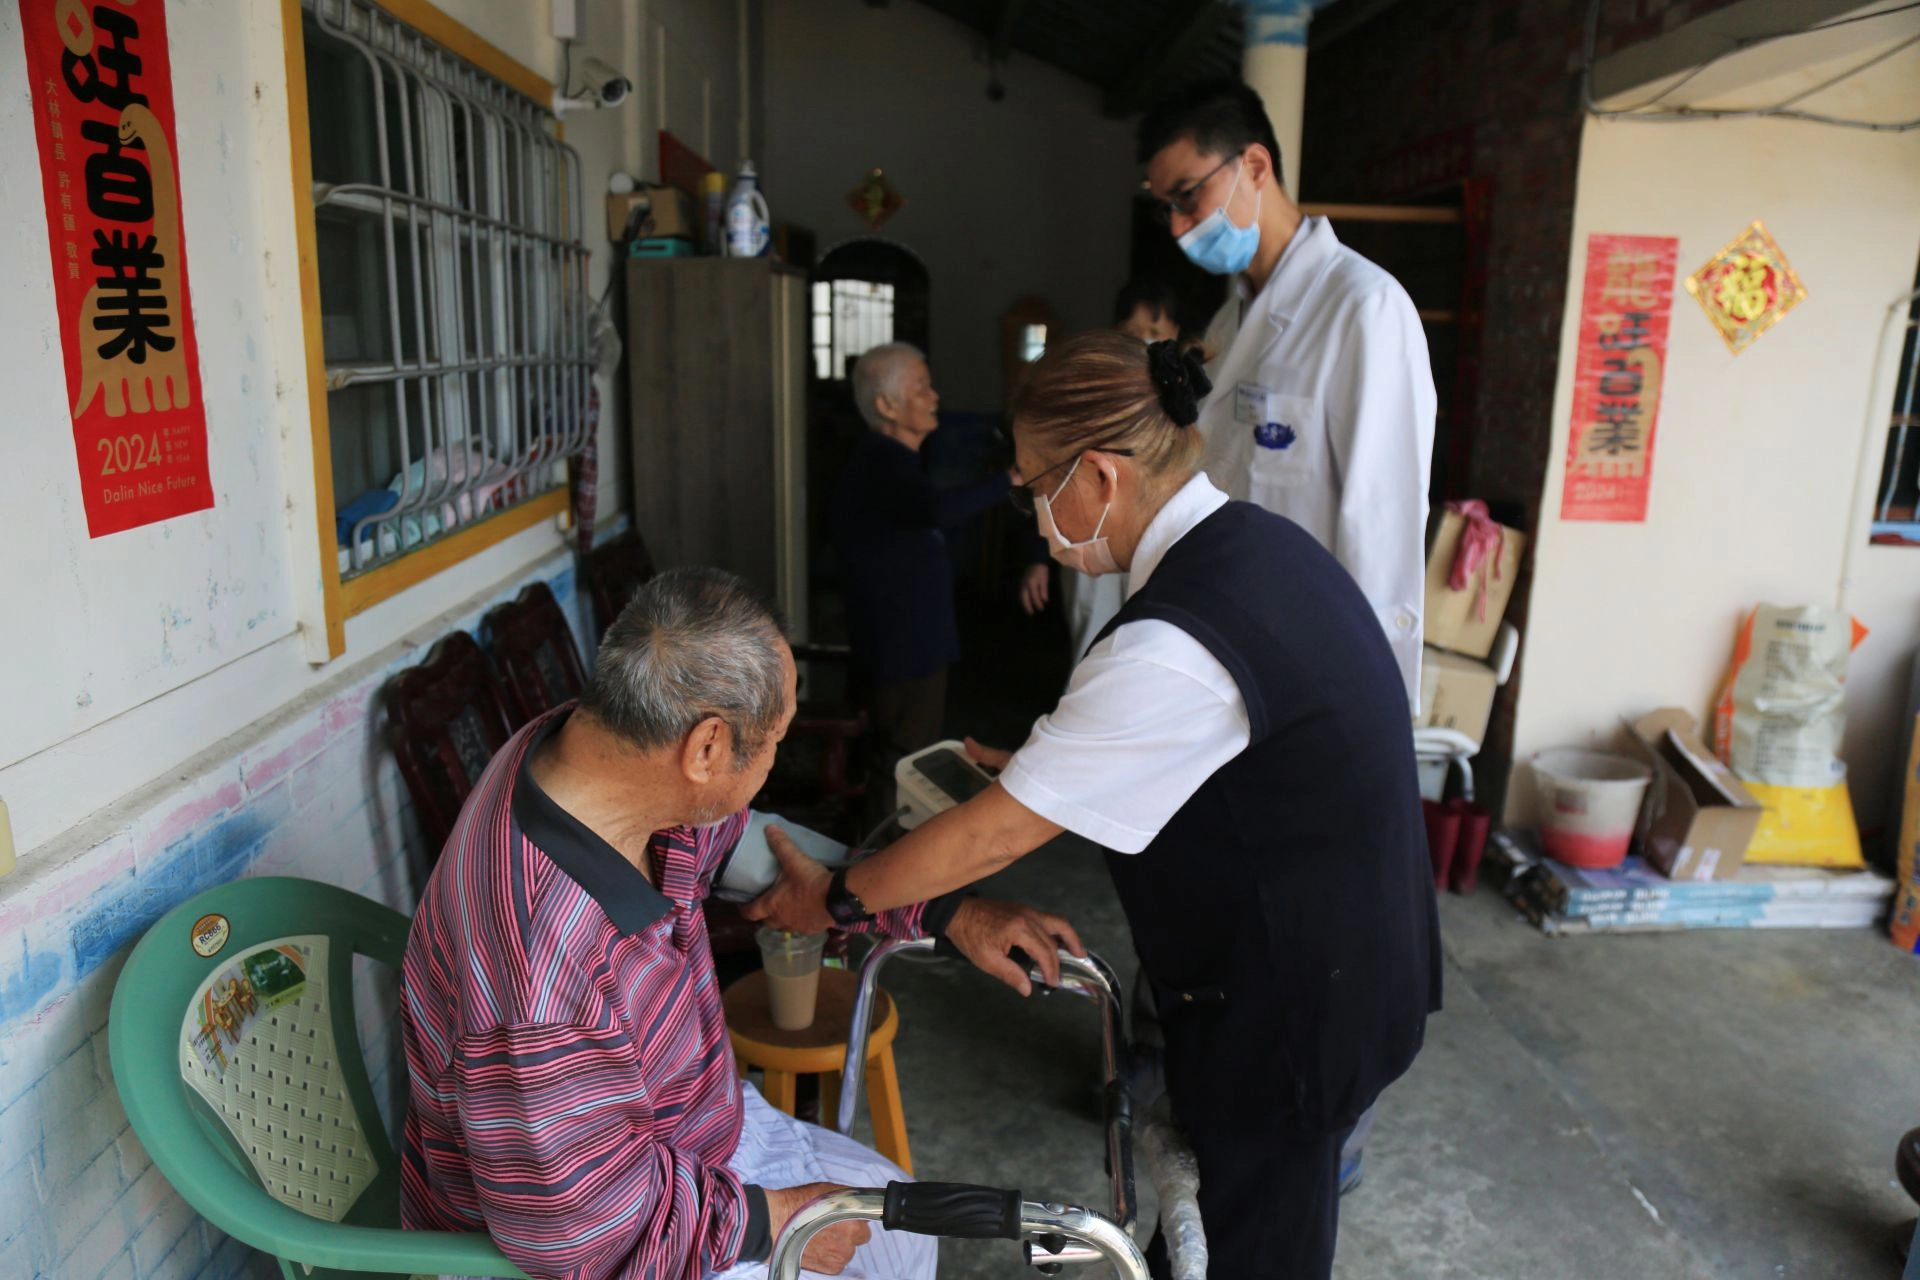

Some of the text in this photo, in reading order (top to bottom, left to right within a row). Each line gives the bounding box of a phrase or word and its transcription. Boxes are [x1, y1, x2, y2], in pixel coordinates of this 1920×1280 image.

[97, 432, 162, 476] 2024
[103, 474, 196, 504] Dalin Nice Future
